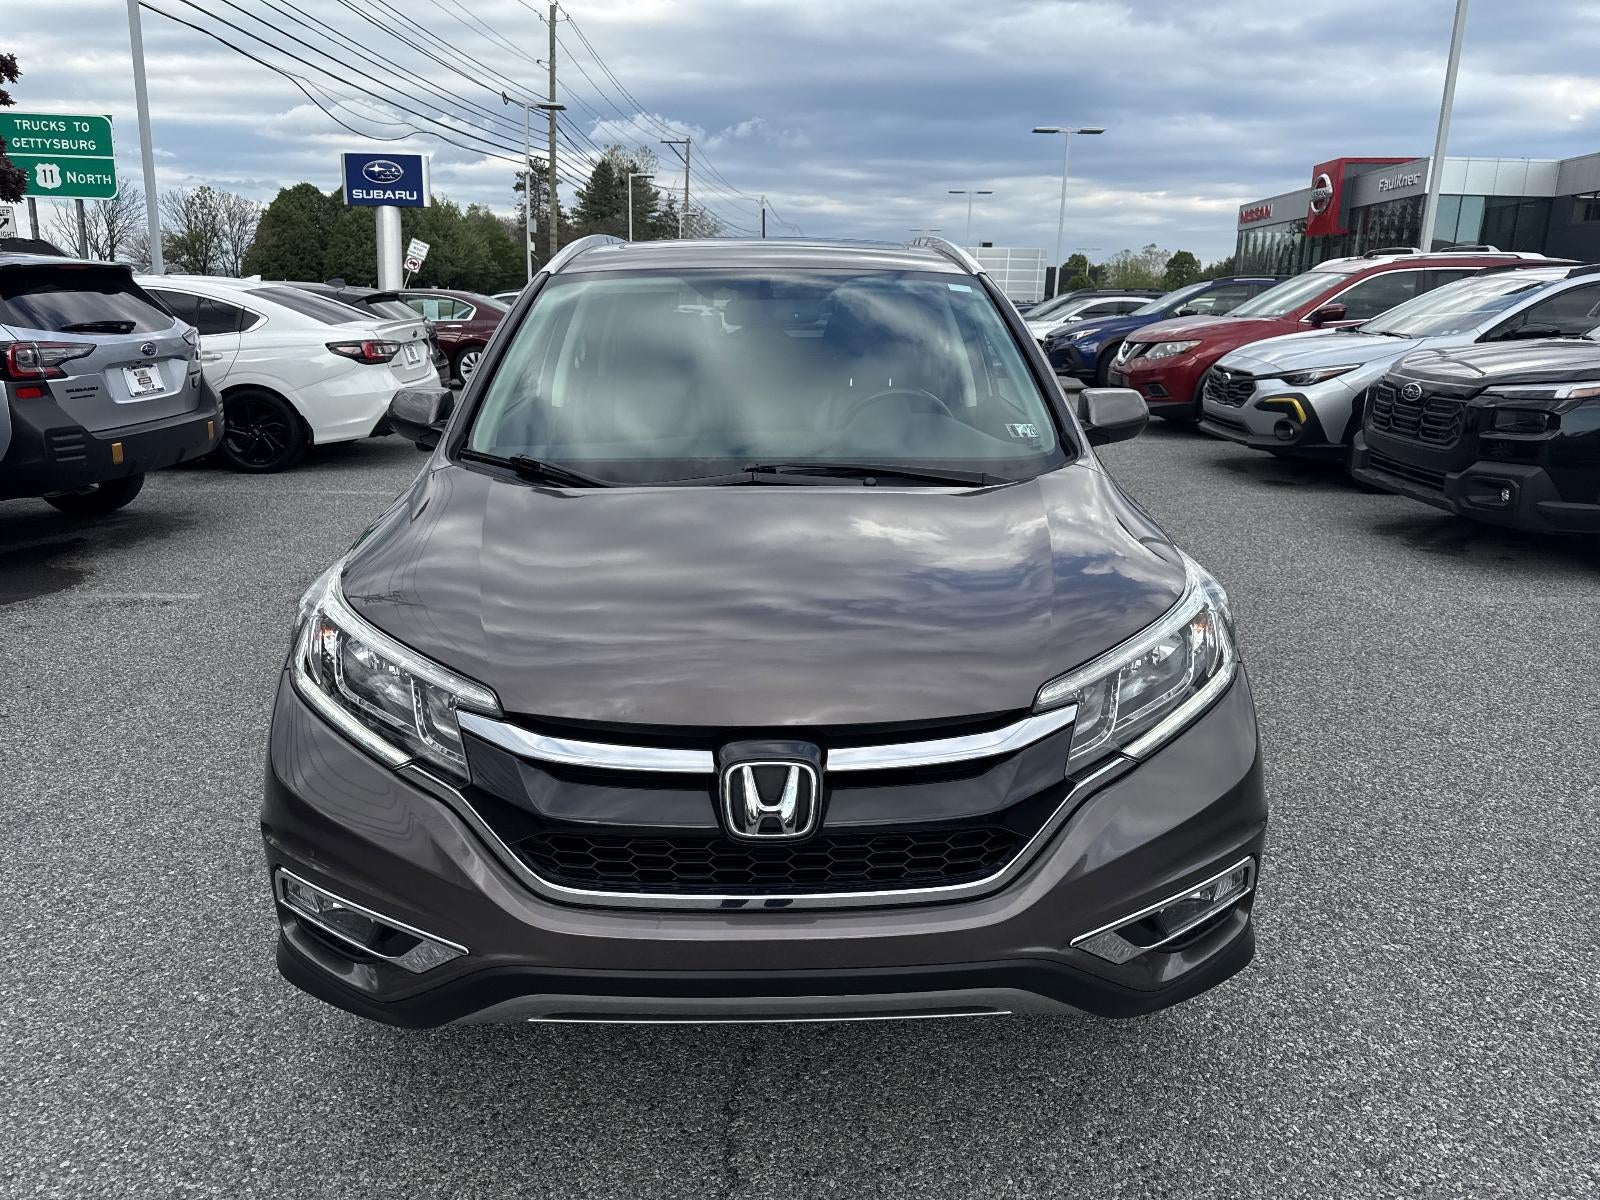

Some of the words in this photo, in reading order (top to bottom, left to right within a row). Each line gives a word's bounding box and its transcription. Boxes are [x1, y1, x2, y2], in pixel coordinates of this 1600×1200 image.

[14, 120, 66, 132] TRUCKS
[73, 121, 90, 132] TO
[12, 138, 96, 151] GETTYSBURG
[42, 169, 54, 184] 11
[66, 171, 112, 185] NORTH
[1379, 173, 1420, 192] Faulkner
[352, 189, 418, 200] SUBARU
[1240, 204, 1273, 223] NISSAN
